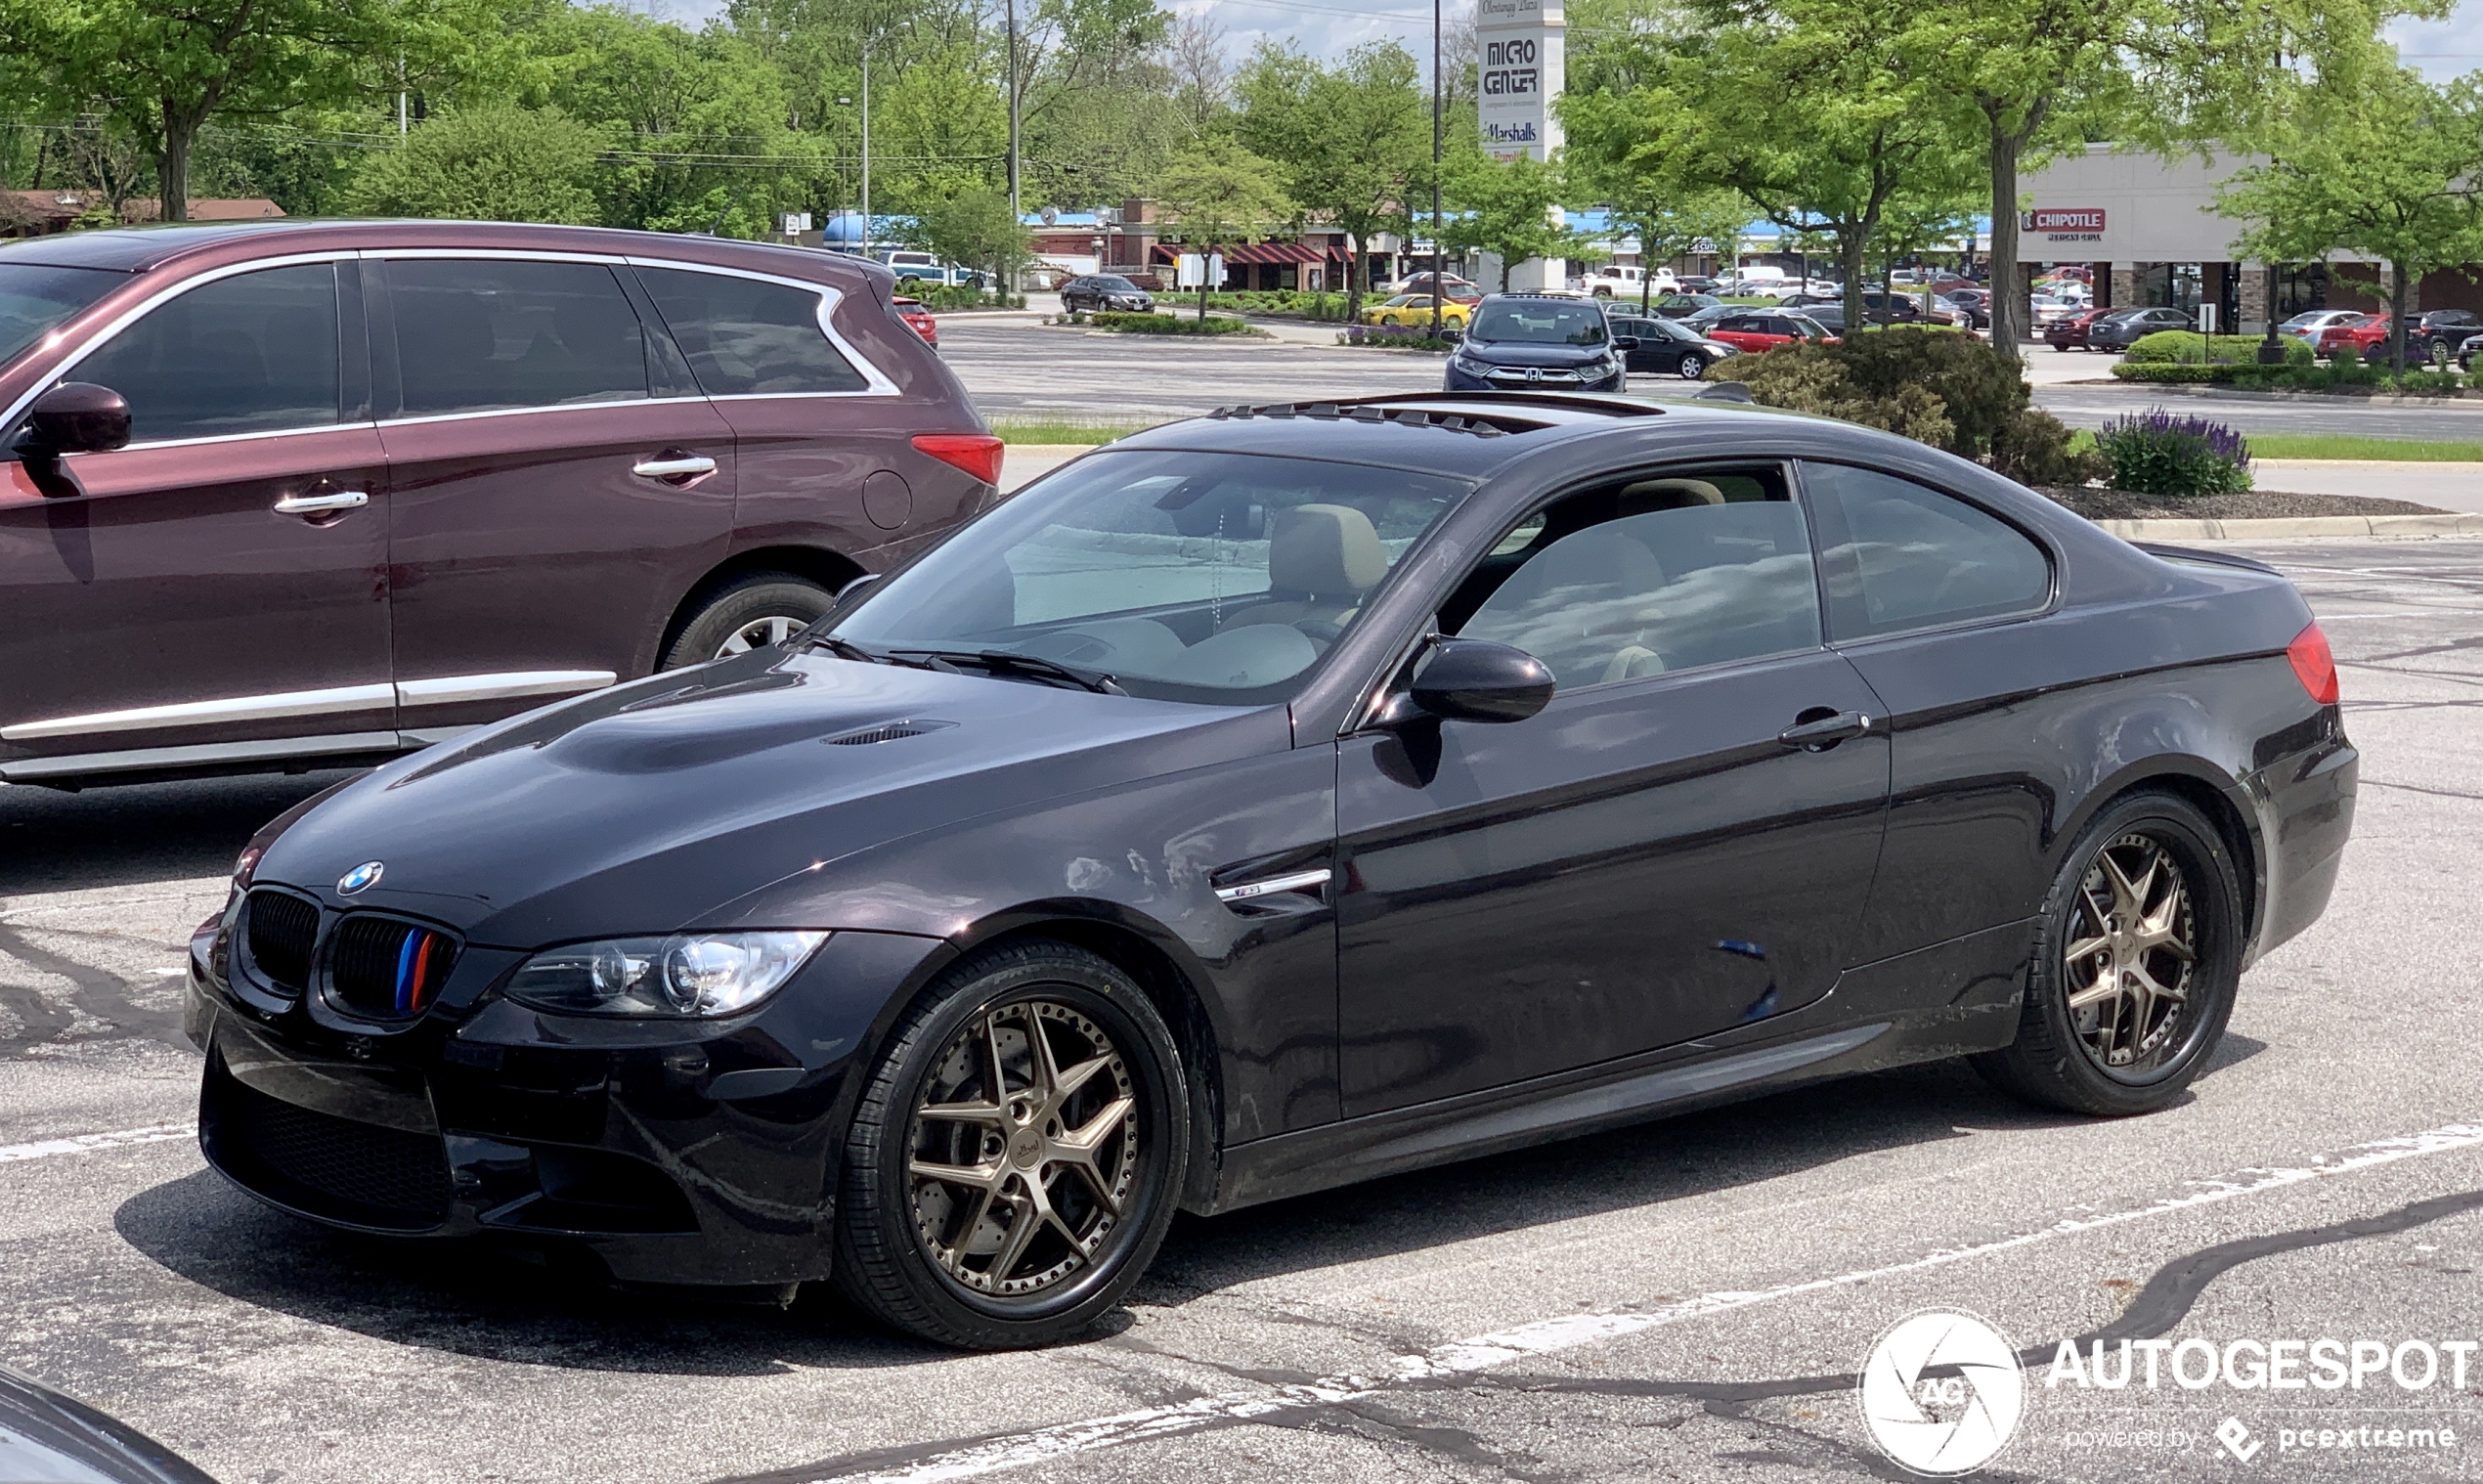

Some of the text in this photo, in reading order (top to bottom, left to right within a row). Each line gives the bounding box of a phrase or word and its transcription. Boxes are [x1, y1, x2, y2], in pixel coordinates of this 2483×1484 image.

[1488, 39, 1536, 65] MICRO
[1484, 68, 1537, 95] CENTER
[1490, 122, 1536, 142] Marshalls
[2037, 213, 2101, 227] CHIPOTLE
